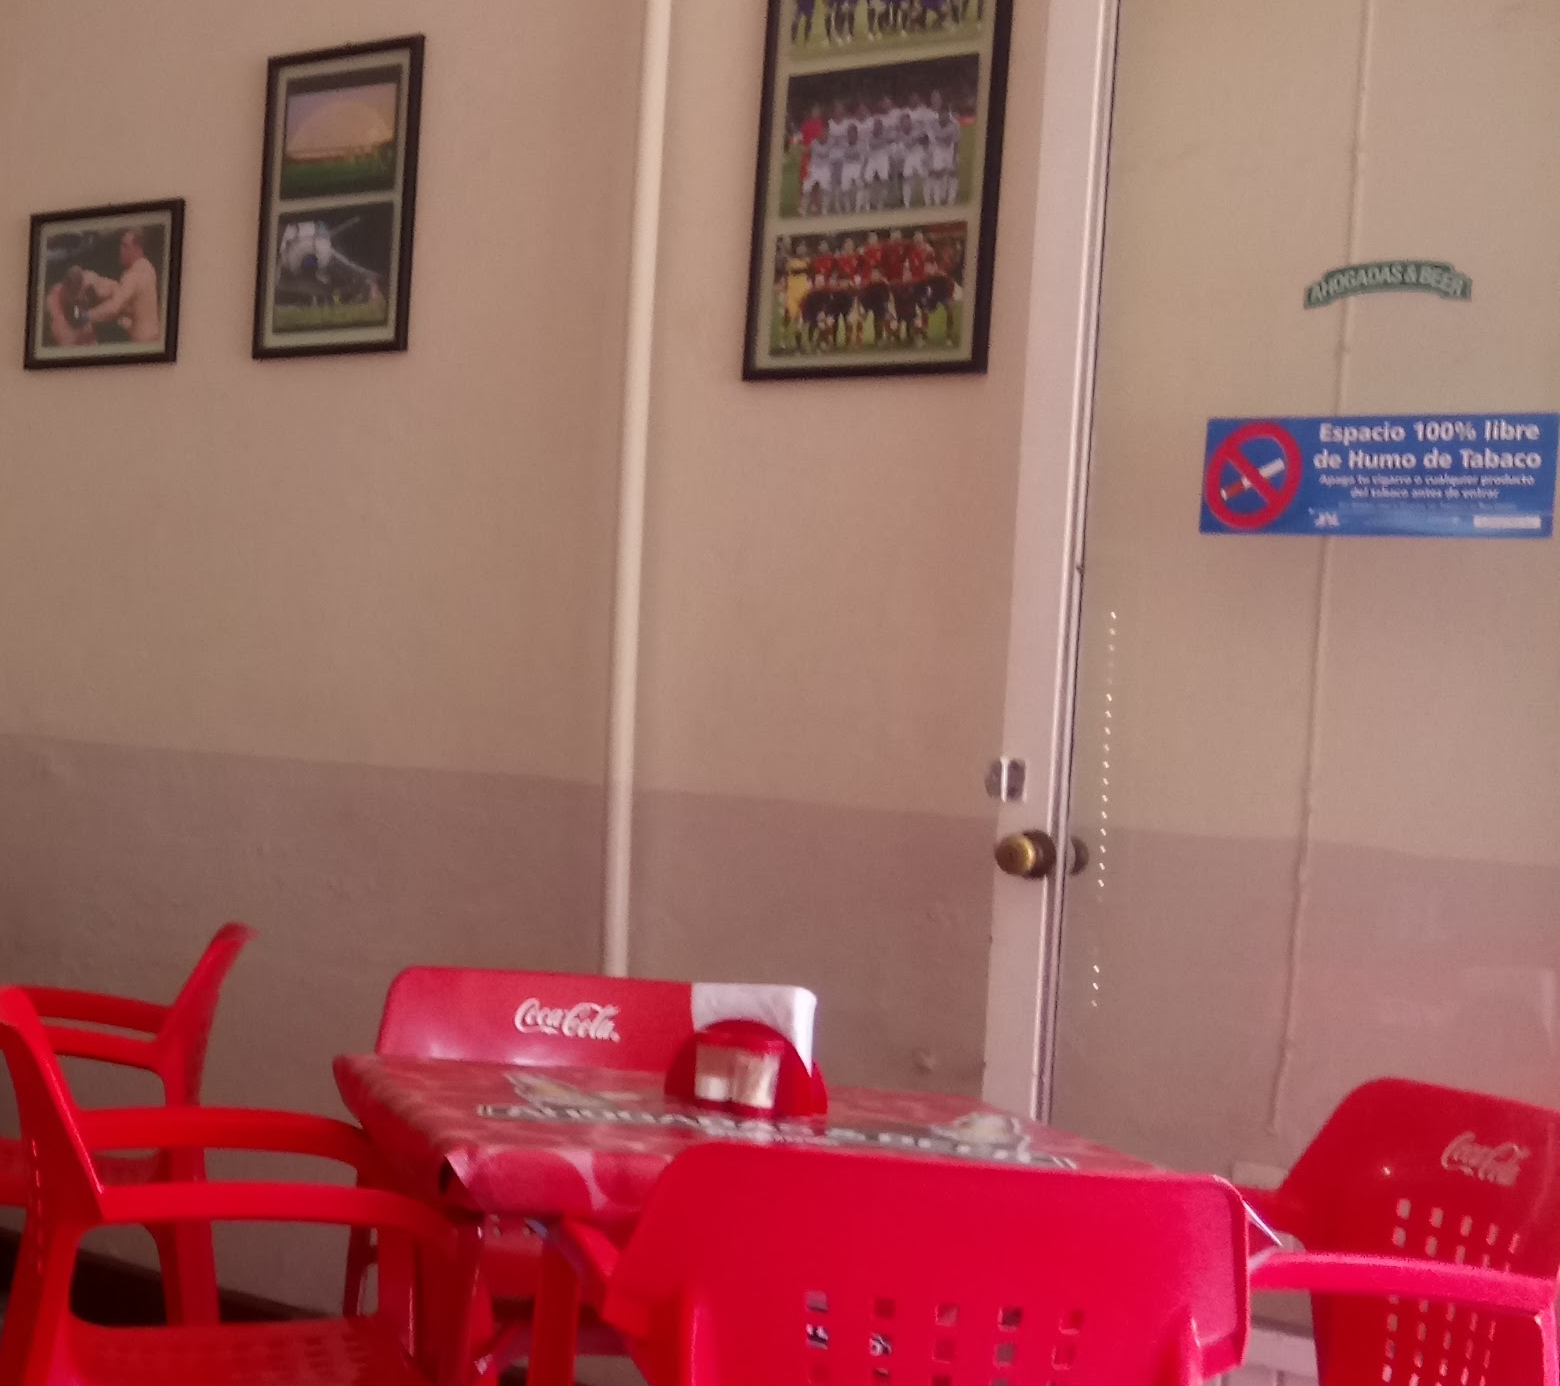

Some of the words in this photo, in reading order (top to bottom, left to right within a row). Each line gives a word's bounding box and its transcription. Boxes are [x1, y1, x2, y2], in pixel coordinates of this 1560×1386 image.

[1319, 422, 1406, 445] Espacio
[1414, 421, 1477, 441] 100%
[1484, 419, 1540, 441] libre
[1313, 448, 1342, 468] de
[1348, 450, 1417, 469] Humo
[1423, 447, 1452, 468] de
[1460, 448, 1542, 469] Tabaco
[514, 997, 621, 1043] Coca-Cola
